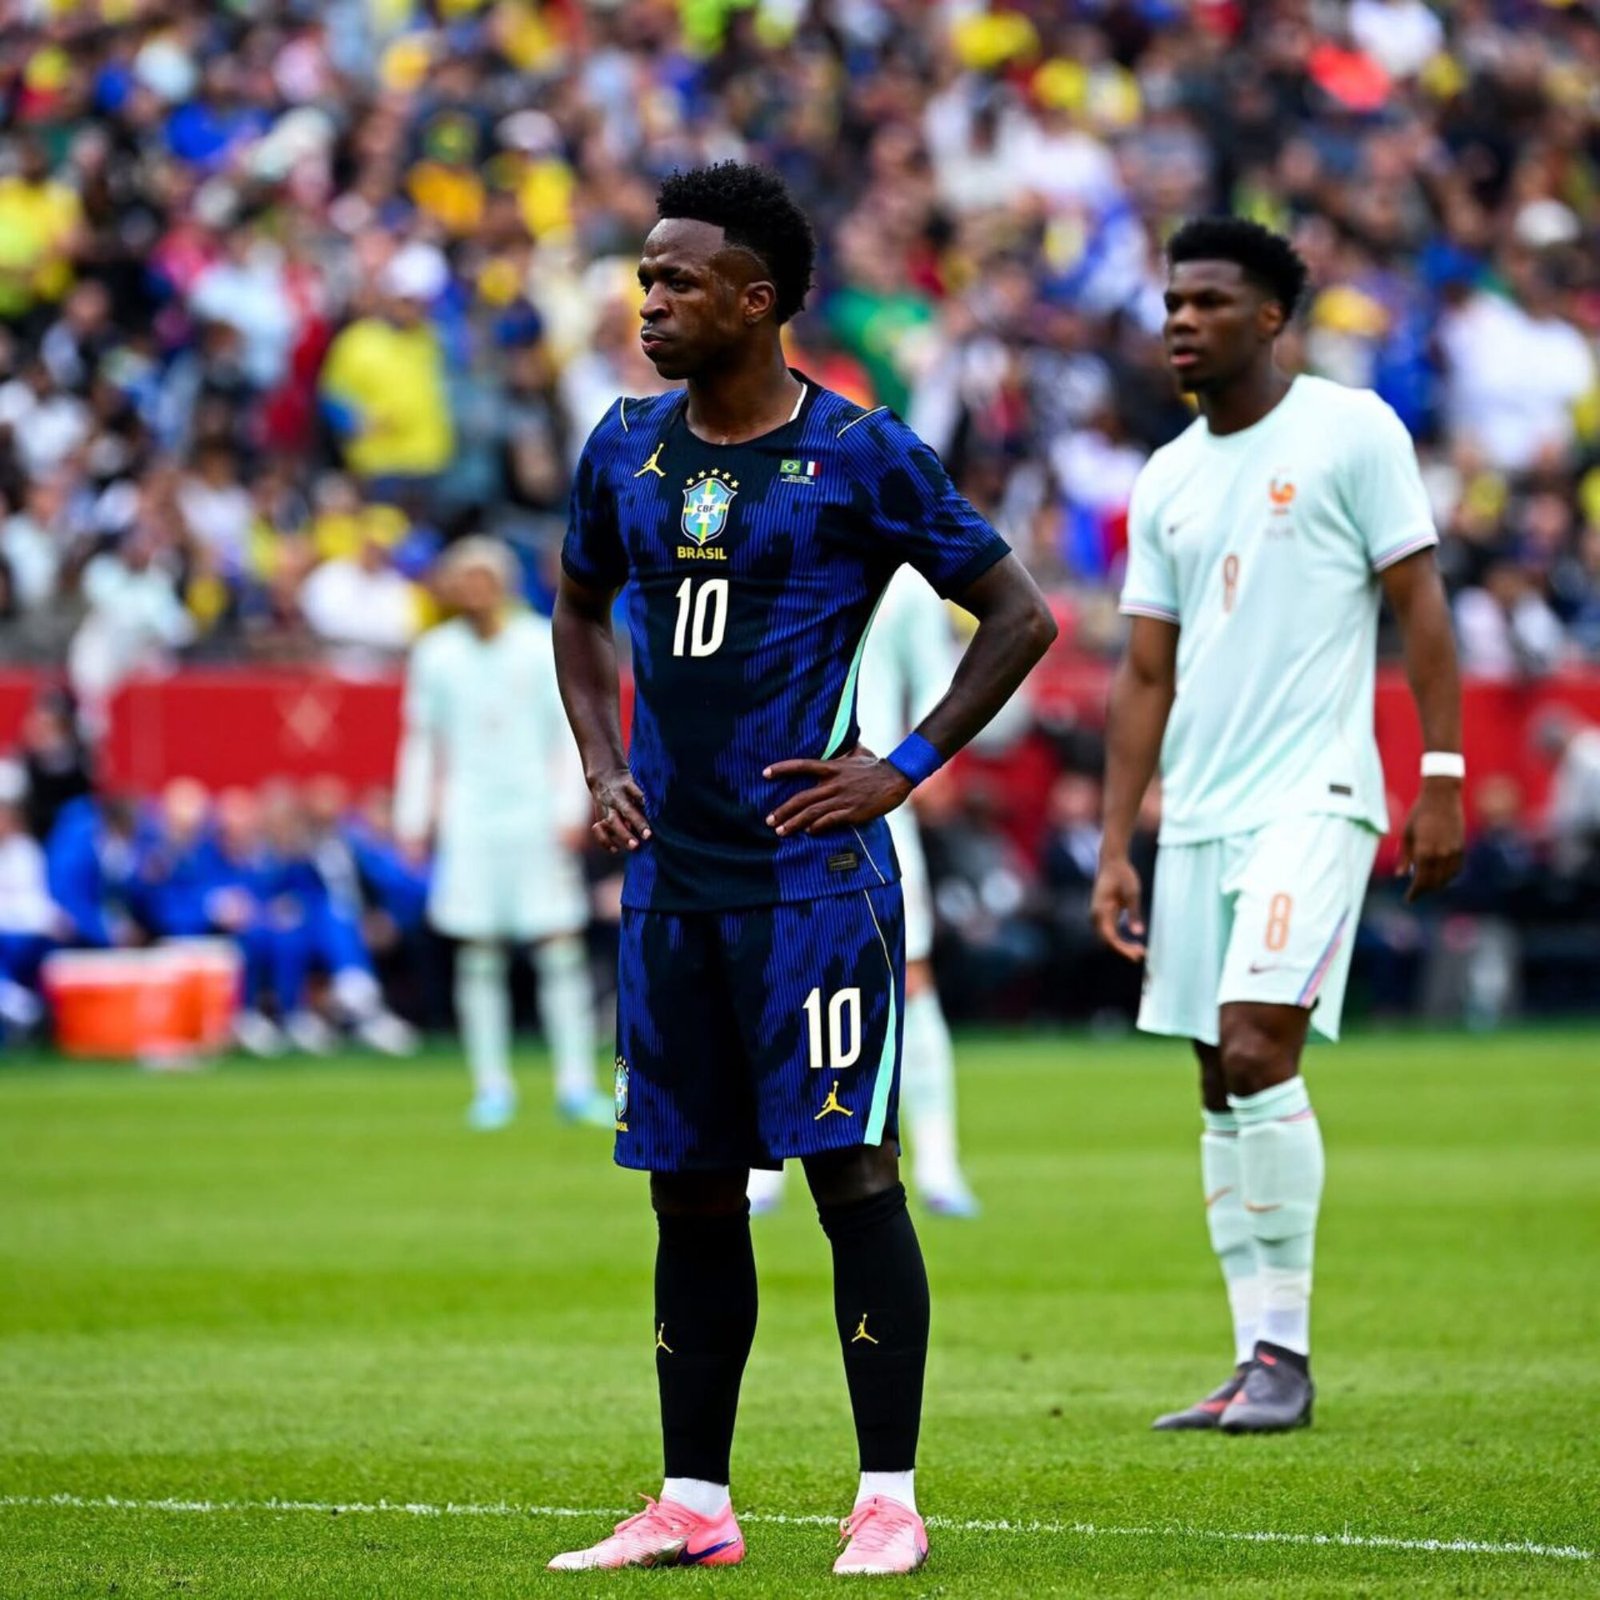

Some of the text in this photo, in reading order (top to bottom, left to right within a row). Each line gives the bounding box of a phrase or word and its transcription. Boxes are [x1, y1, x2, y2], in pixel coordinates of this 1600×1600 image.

[697, 504, 715, 513] CBF
[677, 546, 727, 560] BRASIL
[673, 578, 728, 657] 10
[1264, 892, 1292, 951] 8
[802, 988, 860, 1068] 10
